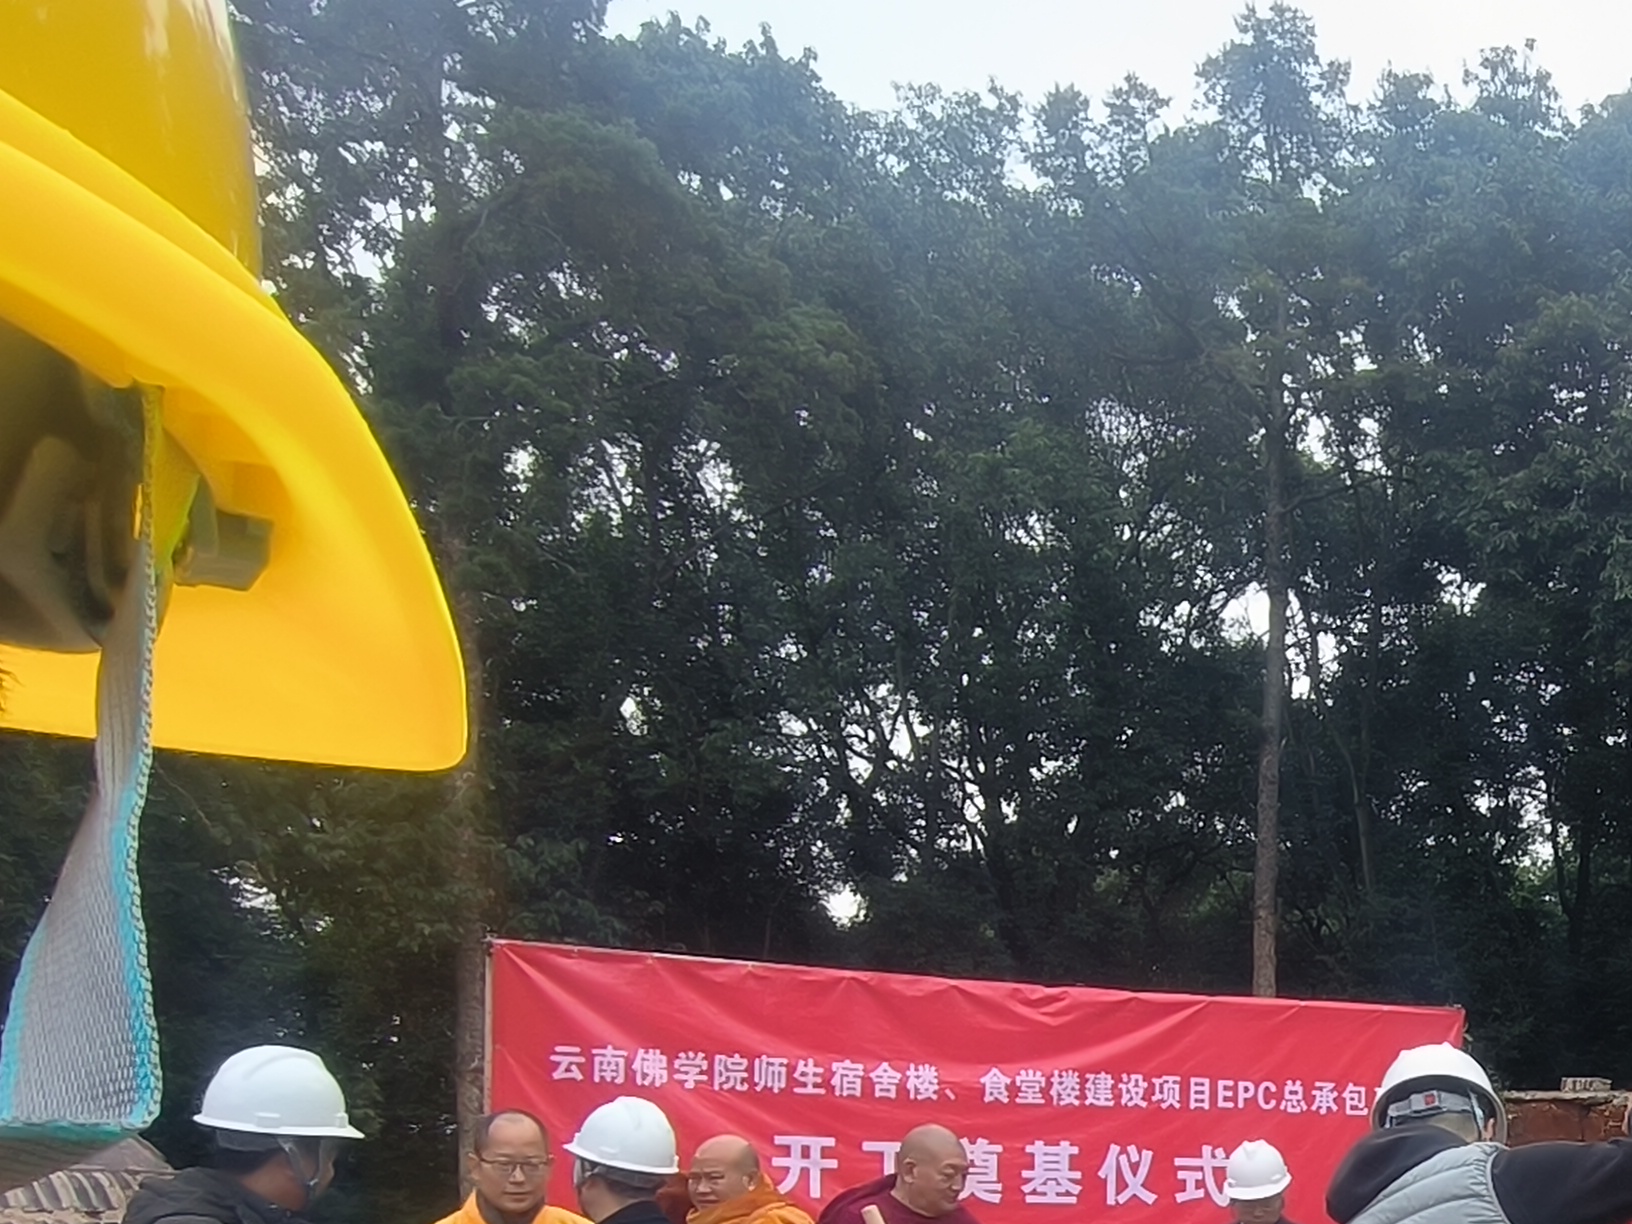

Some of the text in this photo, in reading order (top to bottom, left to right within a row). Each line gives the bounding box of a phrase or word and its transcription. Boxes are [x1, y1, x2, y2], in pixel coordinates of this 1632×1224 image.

[549, 1044, 1384, 1116] 云南佛学院师生宿舍楼、食堂楼建设项目EPC总承包
